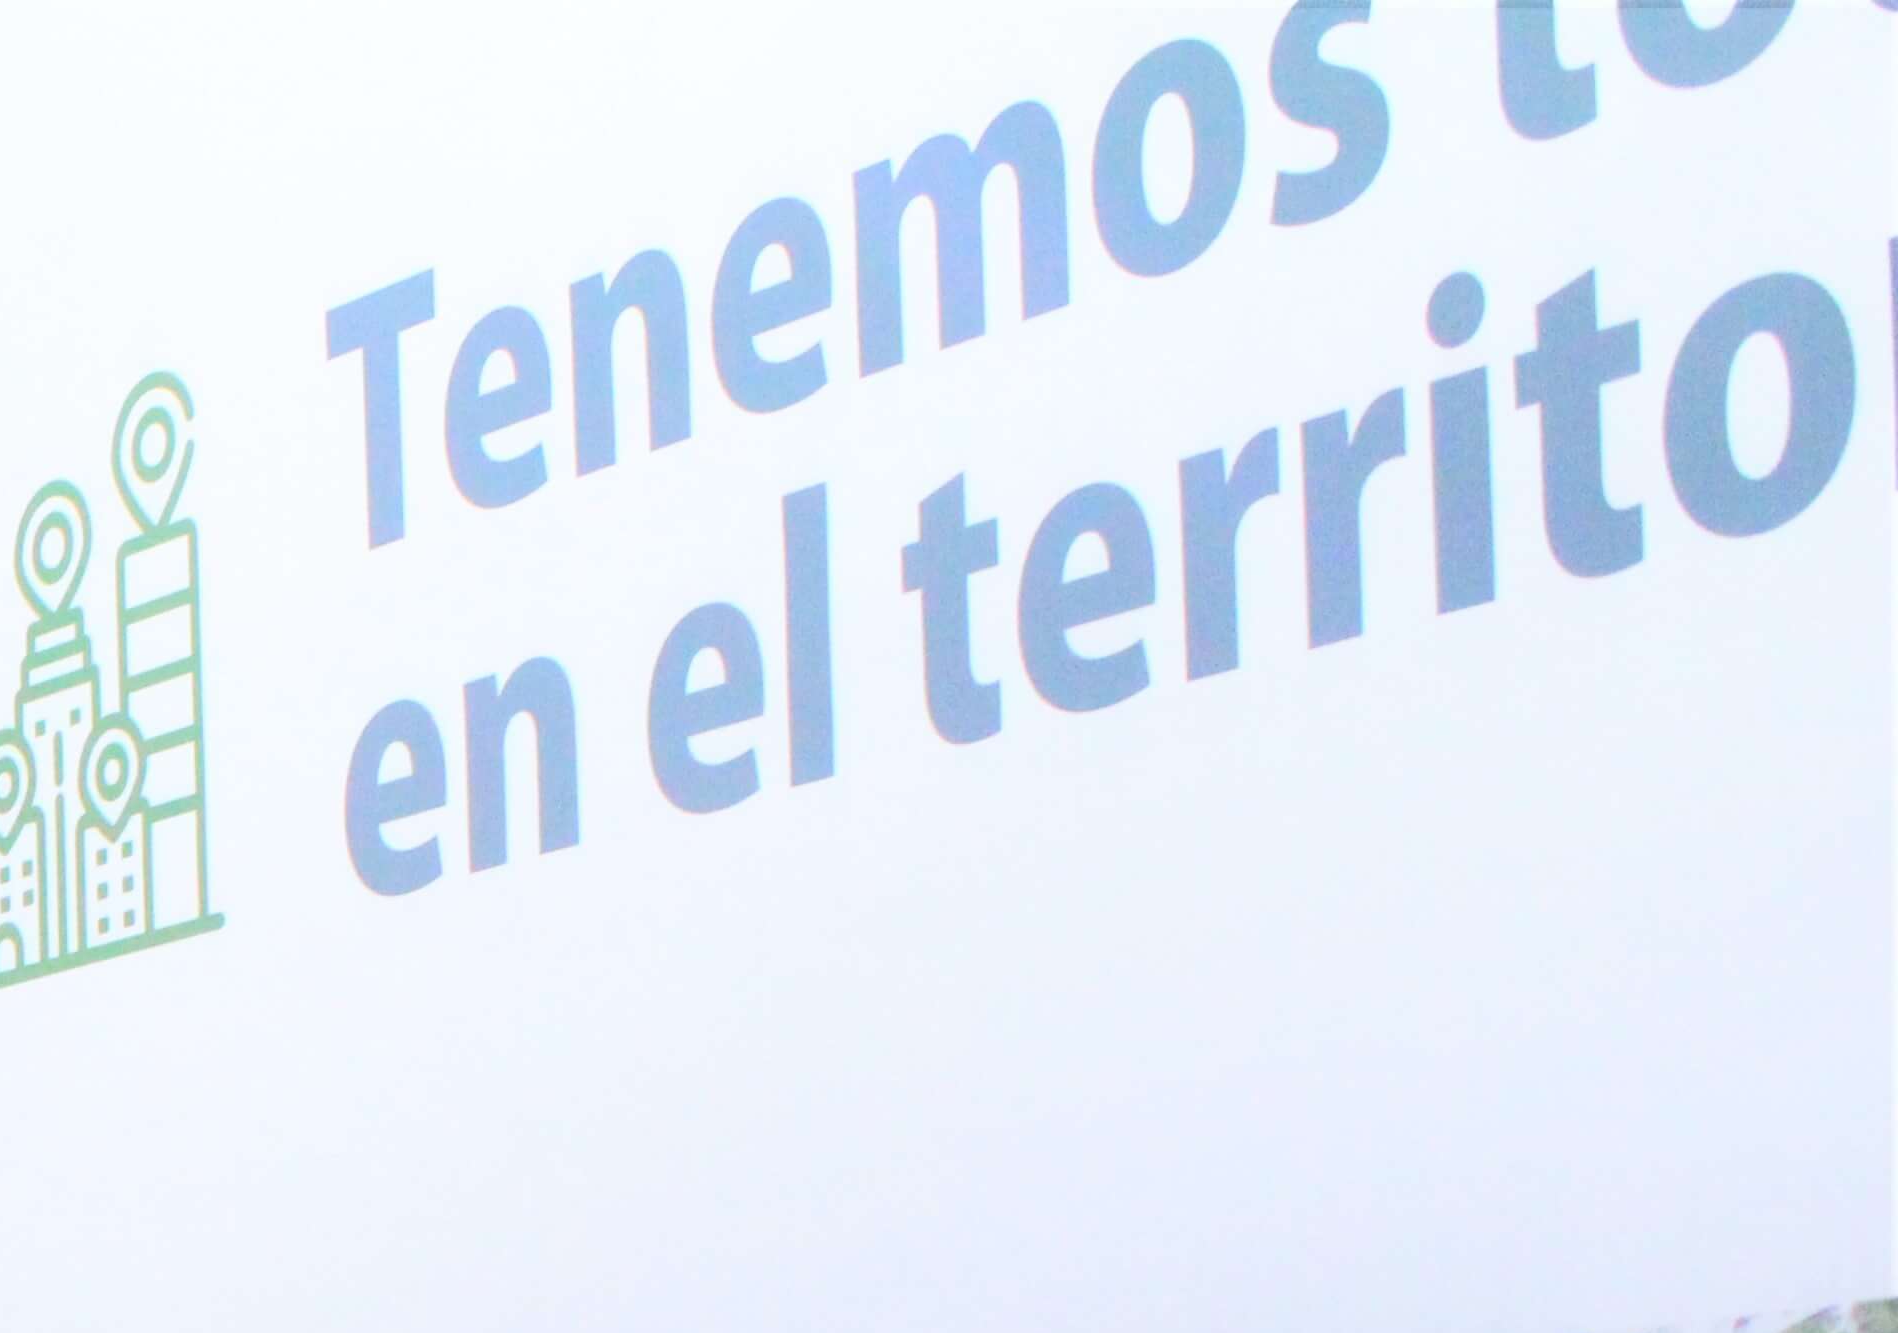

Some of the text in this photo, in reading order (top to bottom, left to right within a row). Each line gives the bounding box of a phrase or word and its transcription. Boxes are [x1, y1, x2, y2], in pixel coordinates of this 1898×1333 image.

[325, 0, 1394, 547] Tenemos
[344, 236, 1898, 898] en el territo
